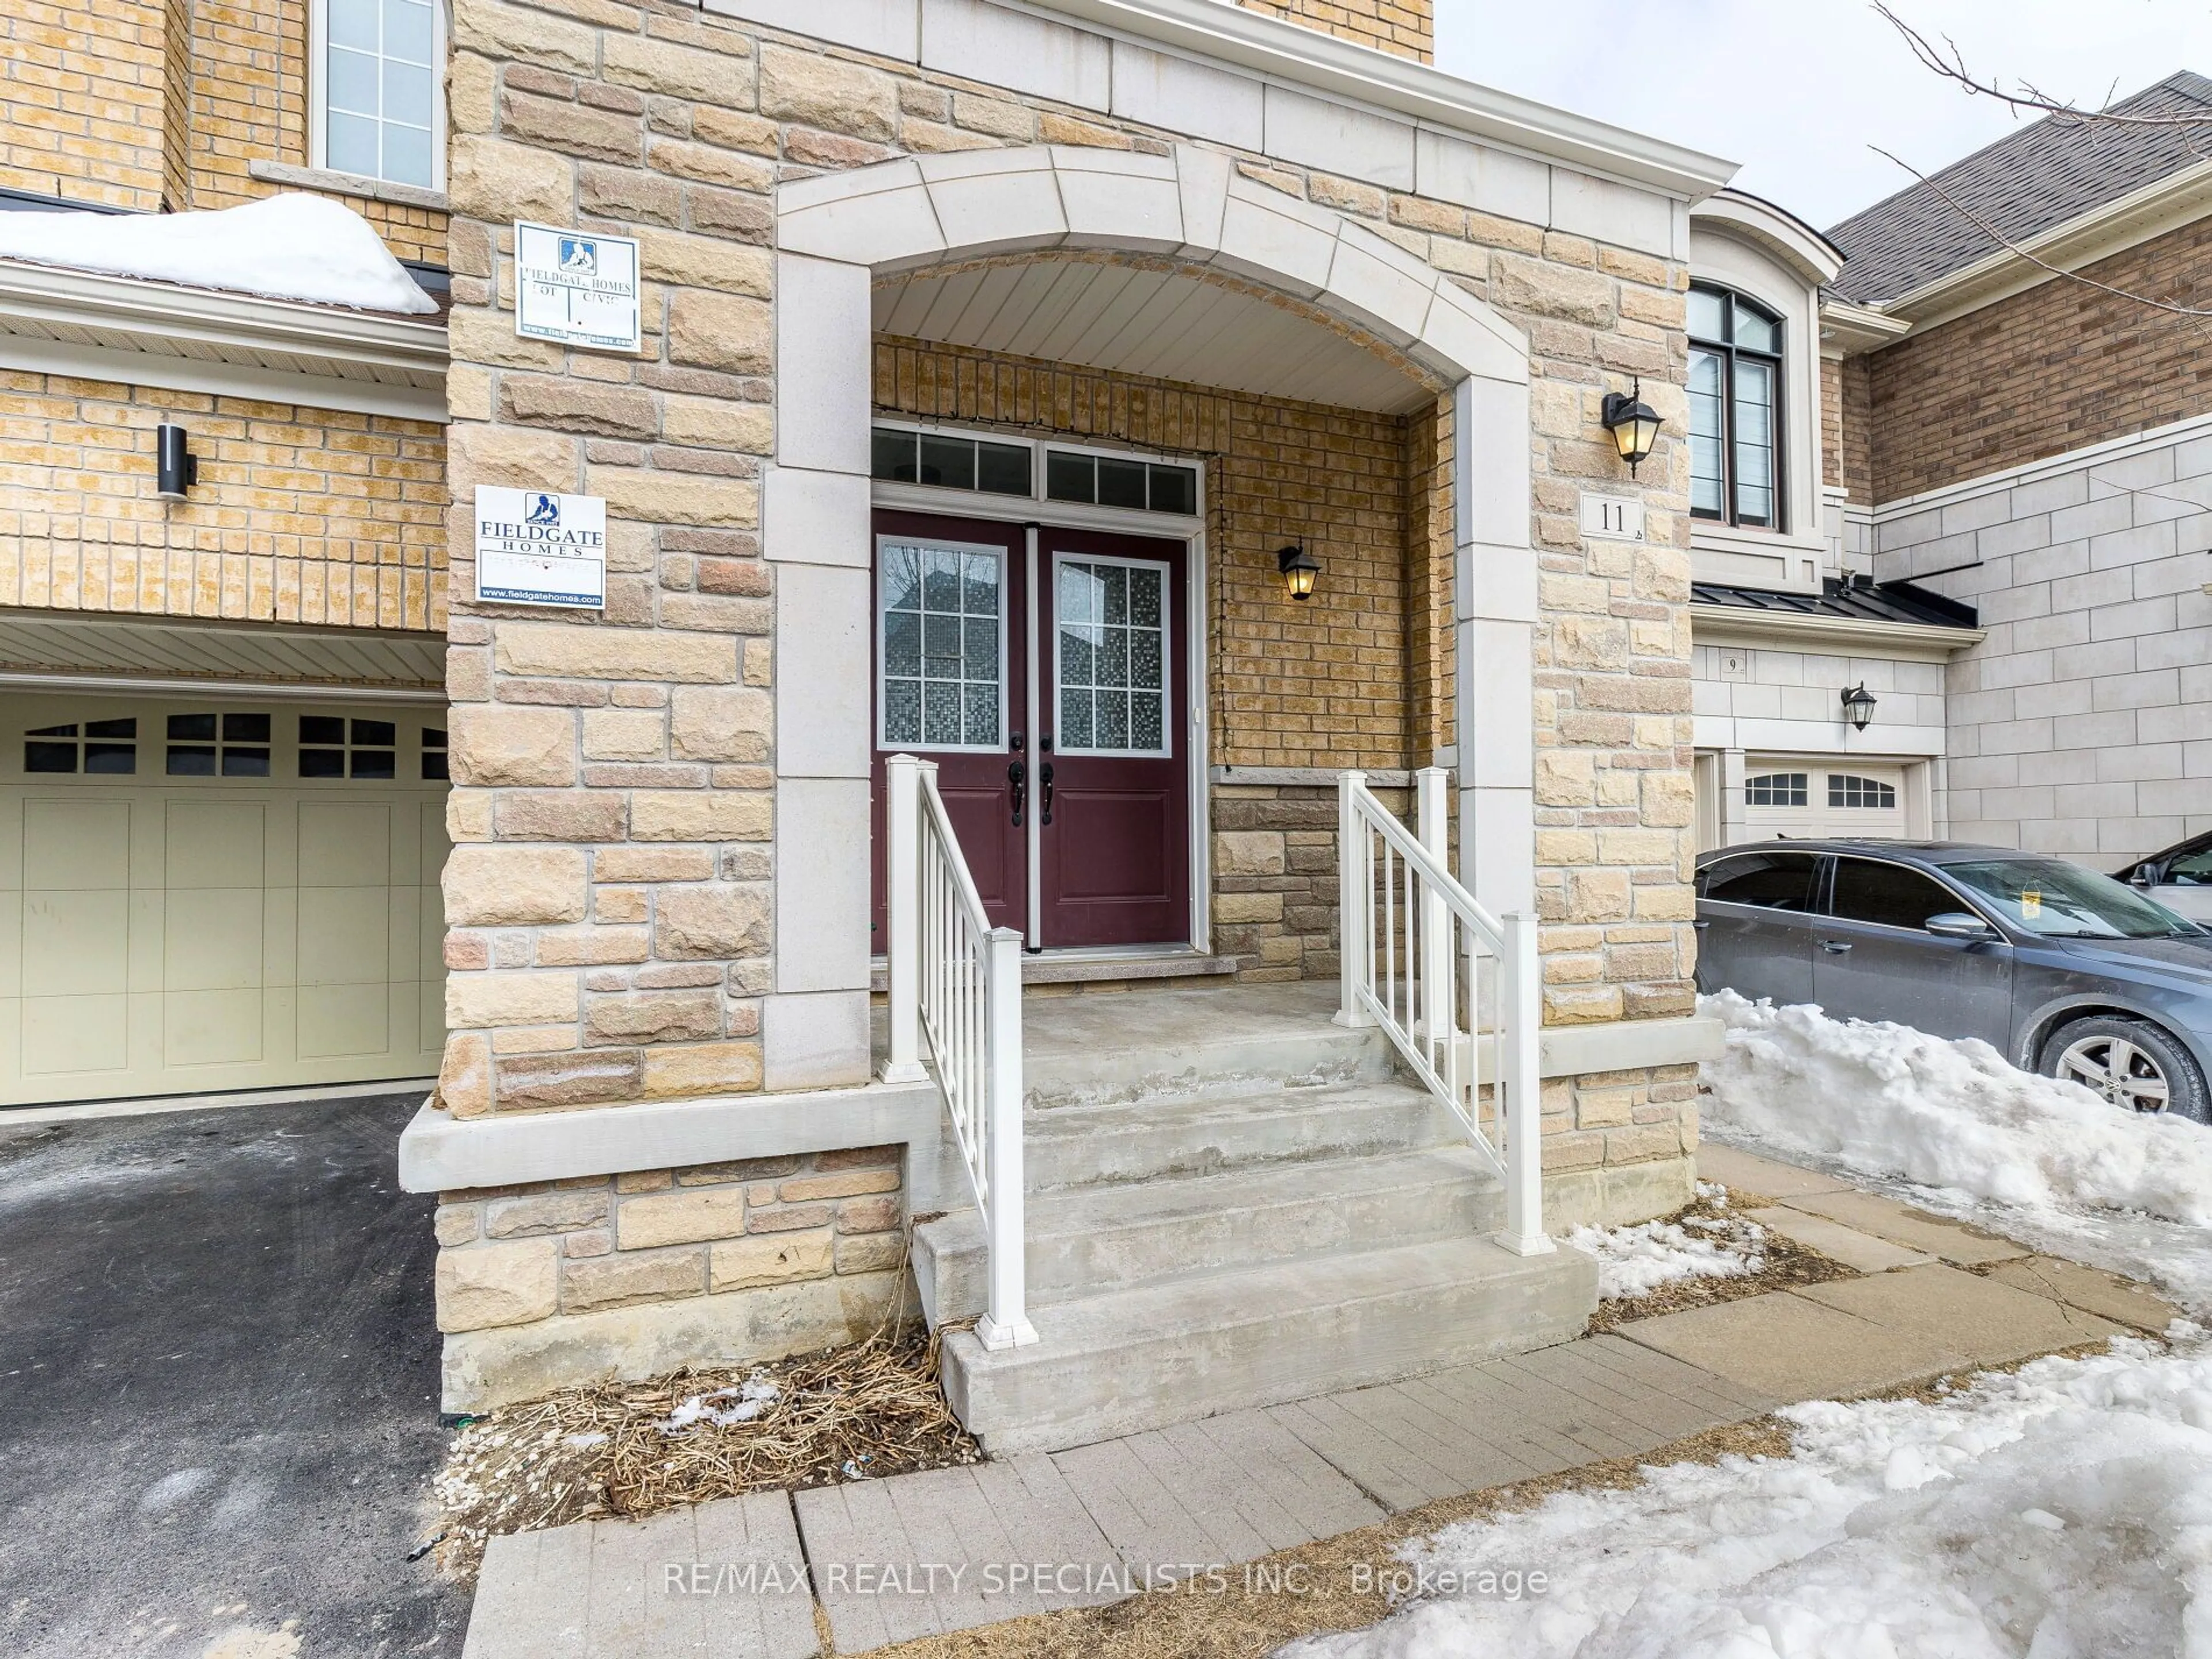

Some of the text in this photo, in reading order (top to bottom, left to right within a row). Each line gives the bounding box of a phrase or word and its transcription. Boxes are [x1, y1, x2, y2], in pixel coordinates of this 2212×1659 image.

[593, 279, 631, 293] HOMES
[1602, 503, 1623, 532] 11
[481, 521, 603, 546] FIELDGATE
[503, 541, 582, 556] HOMES
[483, 589, 600, 604] www.fieldgatehomes.com
[1729, 658, 1736, 671] 9
